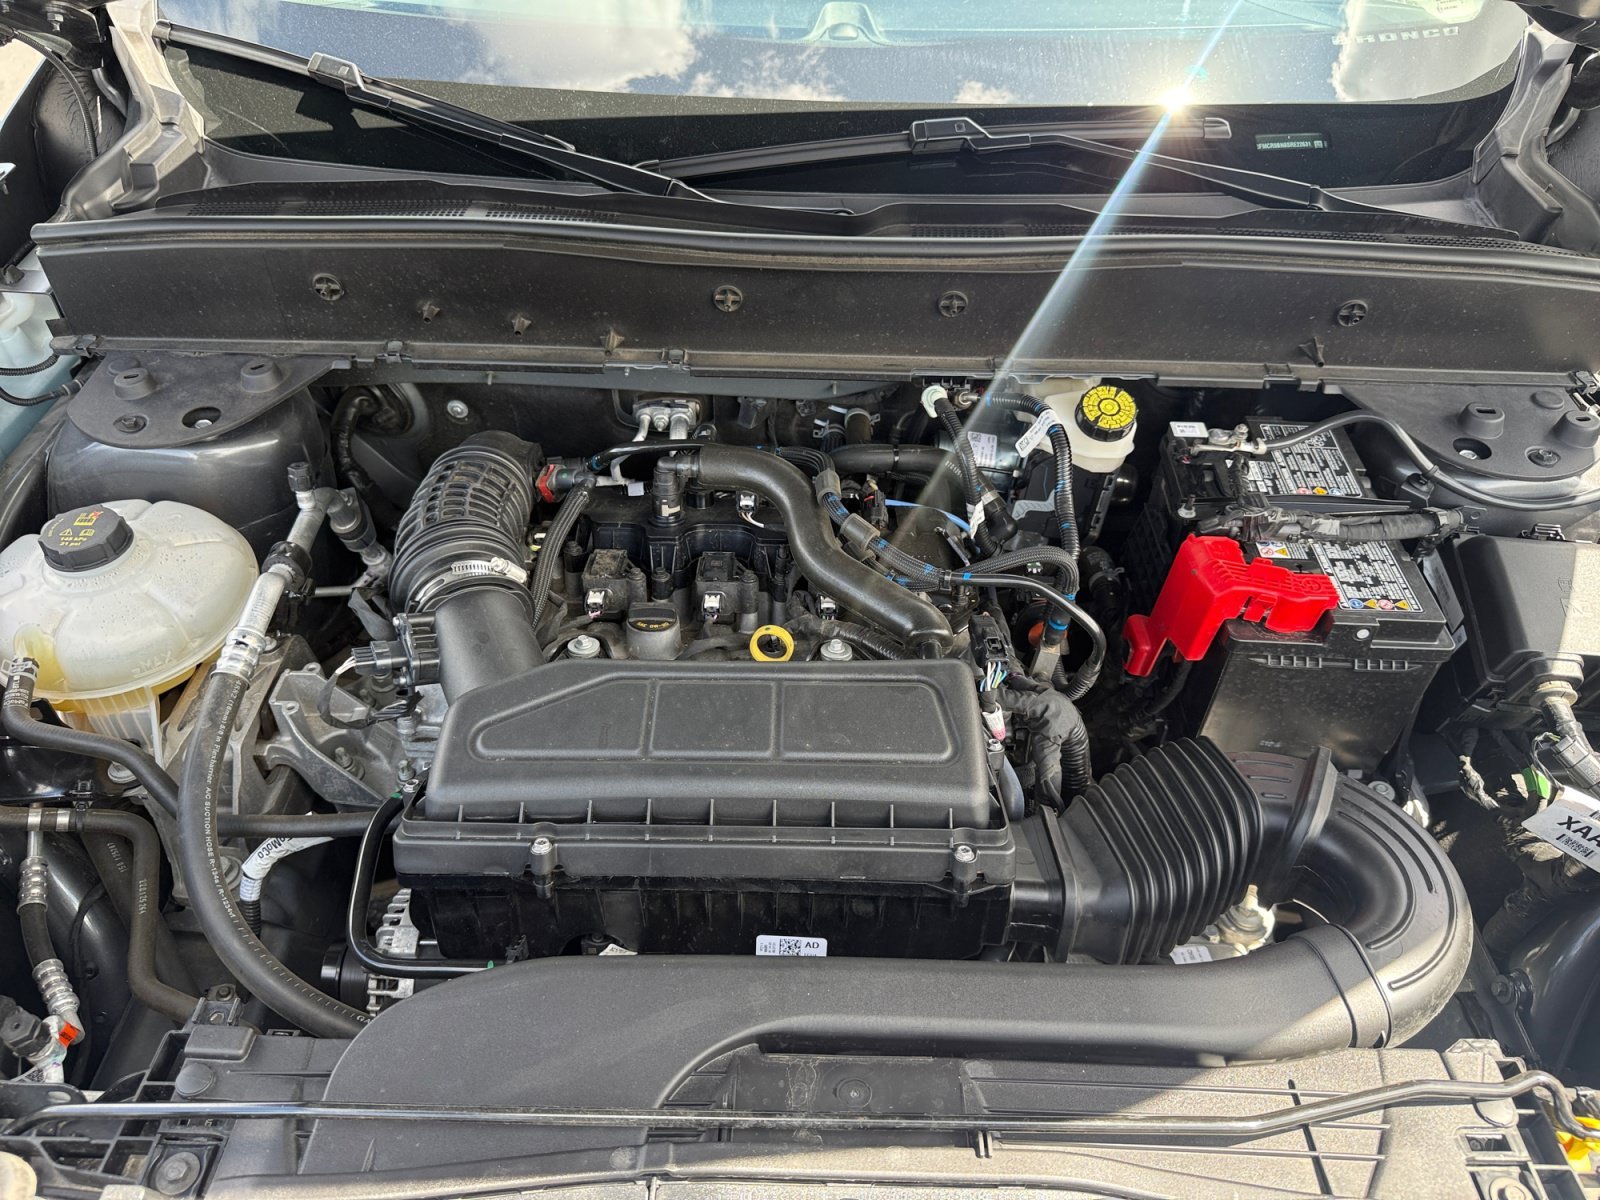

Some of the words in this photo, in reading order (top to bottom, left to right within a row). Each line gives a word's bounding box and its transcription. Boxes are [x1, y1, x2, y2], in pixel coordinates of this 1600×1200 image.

[205, 836, 215, 857] HOSE
[257, 835, 294, 859] oMoCo
[804, 941, 820, 949] AD
